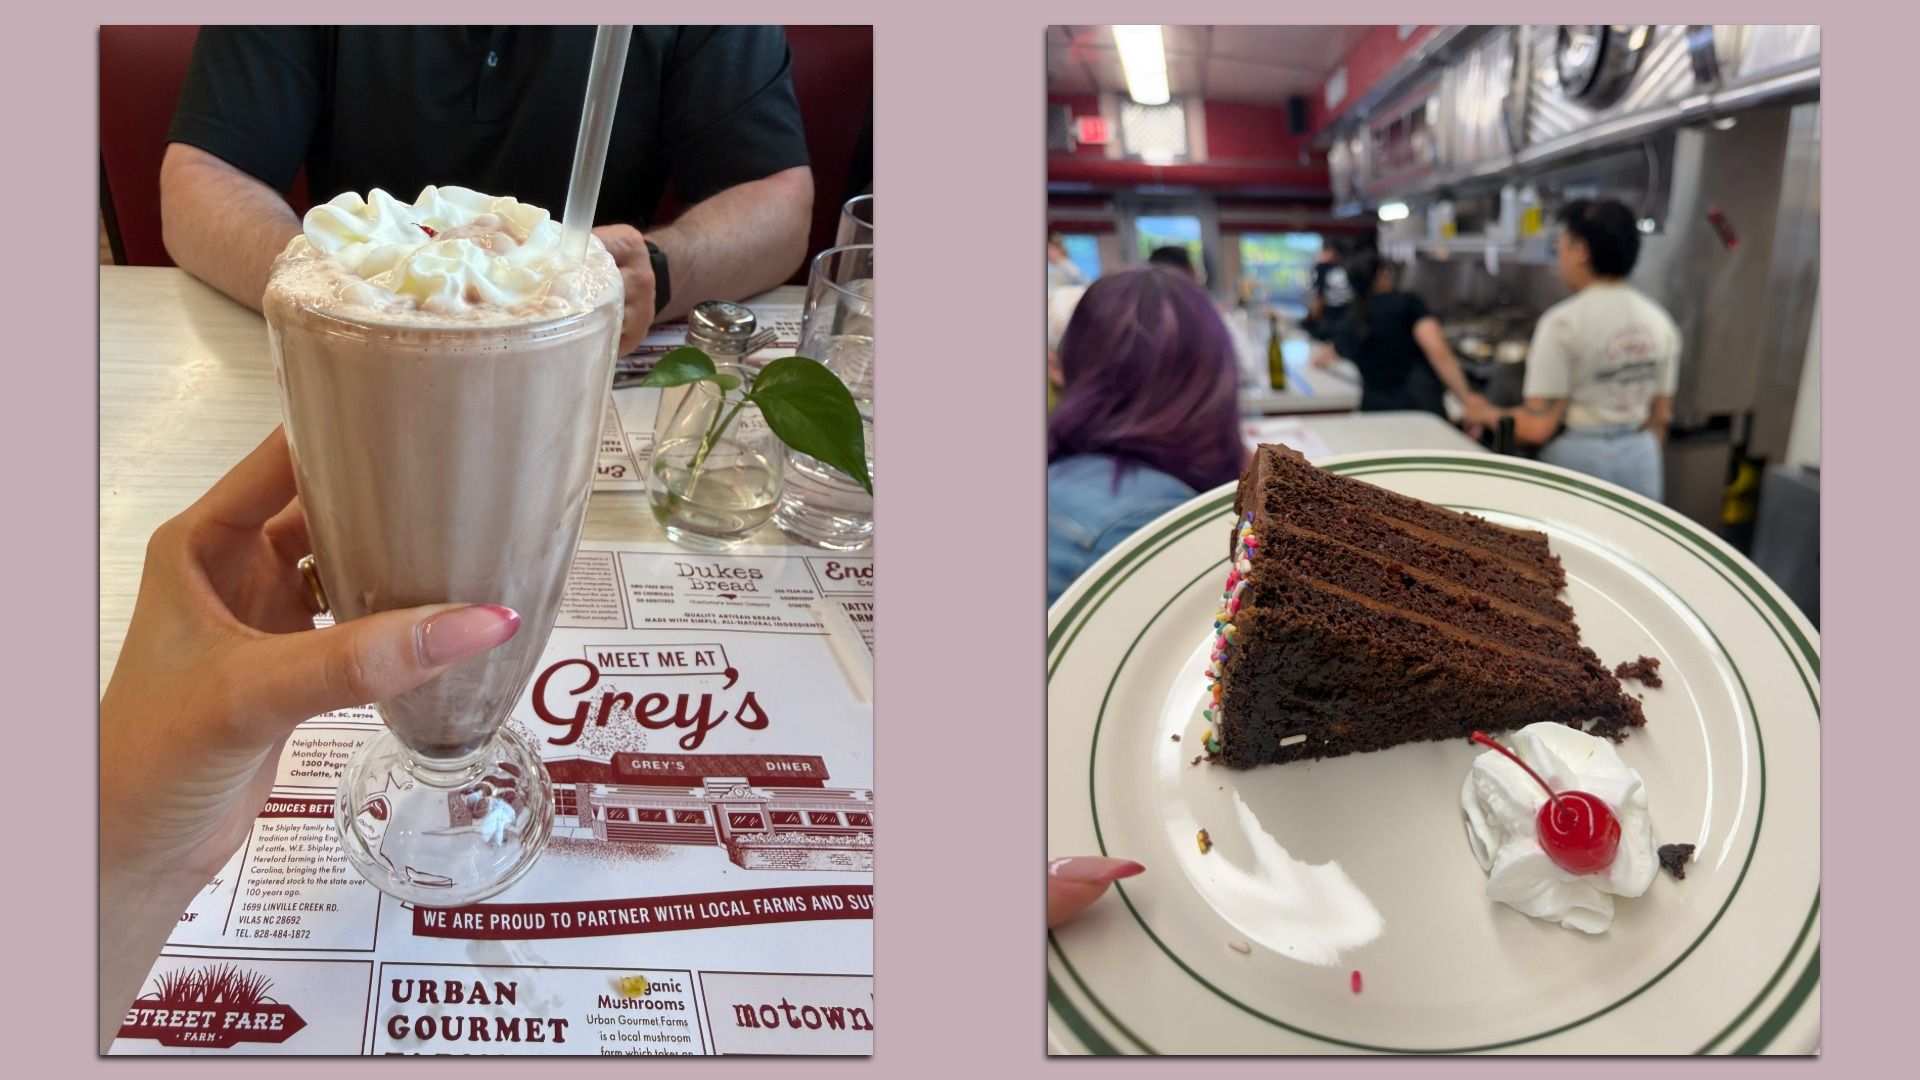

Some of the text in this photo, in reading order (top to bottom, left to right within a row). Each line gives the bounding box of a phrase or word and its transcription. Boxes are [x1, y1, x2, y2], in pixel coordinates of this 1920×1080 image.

[674, 562, 764, 579] Dukes
[688, 578, 759, 592] Bread
[598, 650, 716, 668] MEET ME AT
[531, 658, 769, 750] Grey's
[291, 739, 354, 749] Neighborhood
[291, 750, 349, 760] Monday from
[301, 760, 323, 768] 1300
[631, 759, 813, 773] GREY'S DINER
[290, 769, 332, 779] Charlotte,
[264, 803, 335, 814] ODUCES BETT
[275, 824, 301, 833] Shipley
[302, 824, 324, 833] family
[307, 845, 335, 853] Shipley
[253, 855, 287, 863] Hereford
[287, 855, 316, 864] farming
[250, 866, 346, 876] Carolina, bringing the first
[247, 877, 285, 886] registered
[286, 877, 306, 885] stock
[316, 877, 328, 885] the
[245, 888, 261, 896] 100
[262, 889, 283, 898] years
[242, 902, 339, 912] 1699 LINVILLE CREEK RD.
[422, 910, 447, 928] WE
[452, 912, 484, 930] ARE
[490, 912, 546, 930] PROUD
[550, 911, 571, 929] TO
[577, 907, 651, 928] PARTNER
[653, 904, 696, 923] WITH
[699, 900, 751, 919] LOCAL
[753, 896, 808, 915] FARMS
[811, 894, 844, 911] AND
[180, 912, 199, 922] OF
[238, 915, 301, 925] VILAS NC 28692
[235, 928, 311, 939] TEL. 828-484-1872
[391, 978, 518, 1006] URBAN
[644, 978, 683, 996] ganic
[597, 994, 685, 1011] Mushrooms
[122, 1008, 286, 1031] STREET FARE
[586, 1013, 689, 1027] Urban Gourmet Farms
[387, 1014, 569, 1043] GOURMET
[184, 1032, 216, 1042] FARM
[600, 1030, 608, 1041] is
[617, 1030, 641, 1042] local
[643, 1031, 691, 1043] mushroom
[600, 1046, 623, 1056] farm
[625, 1047, 651, 1056] which
